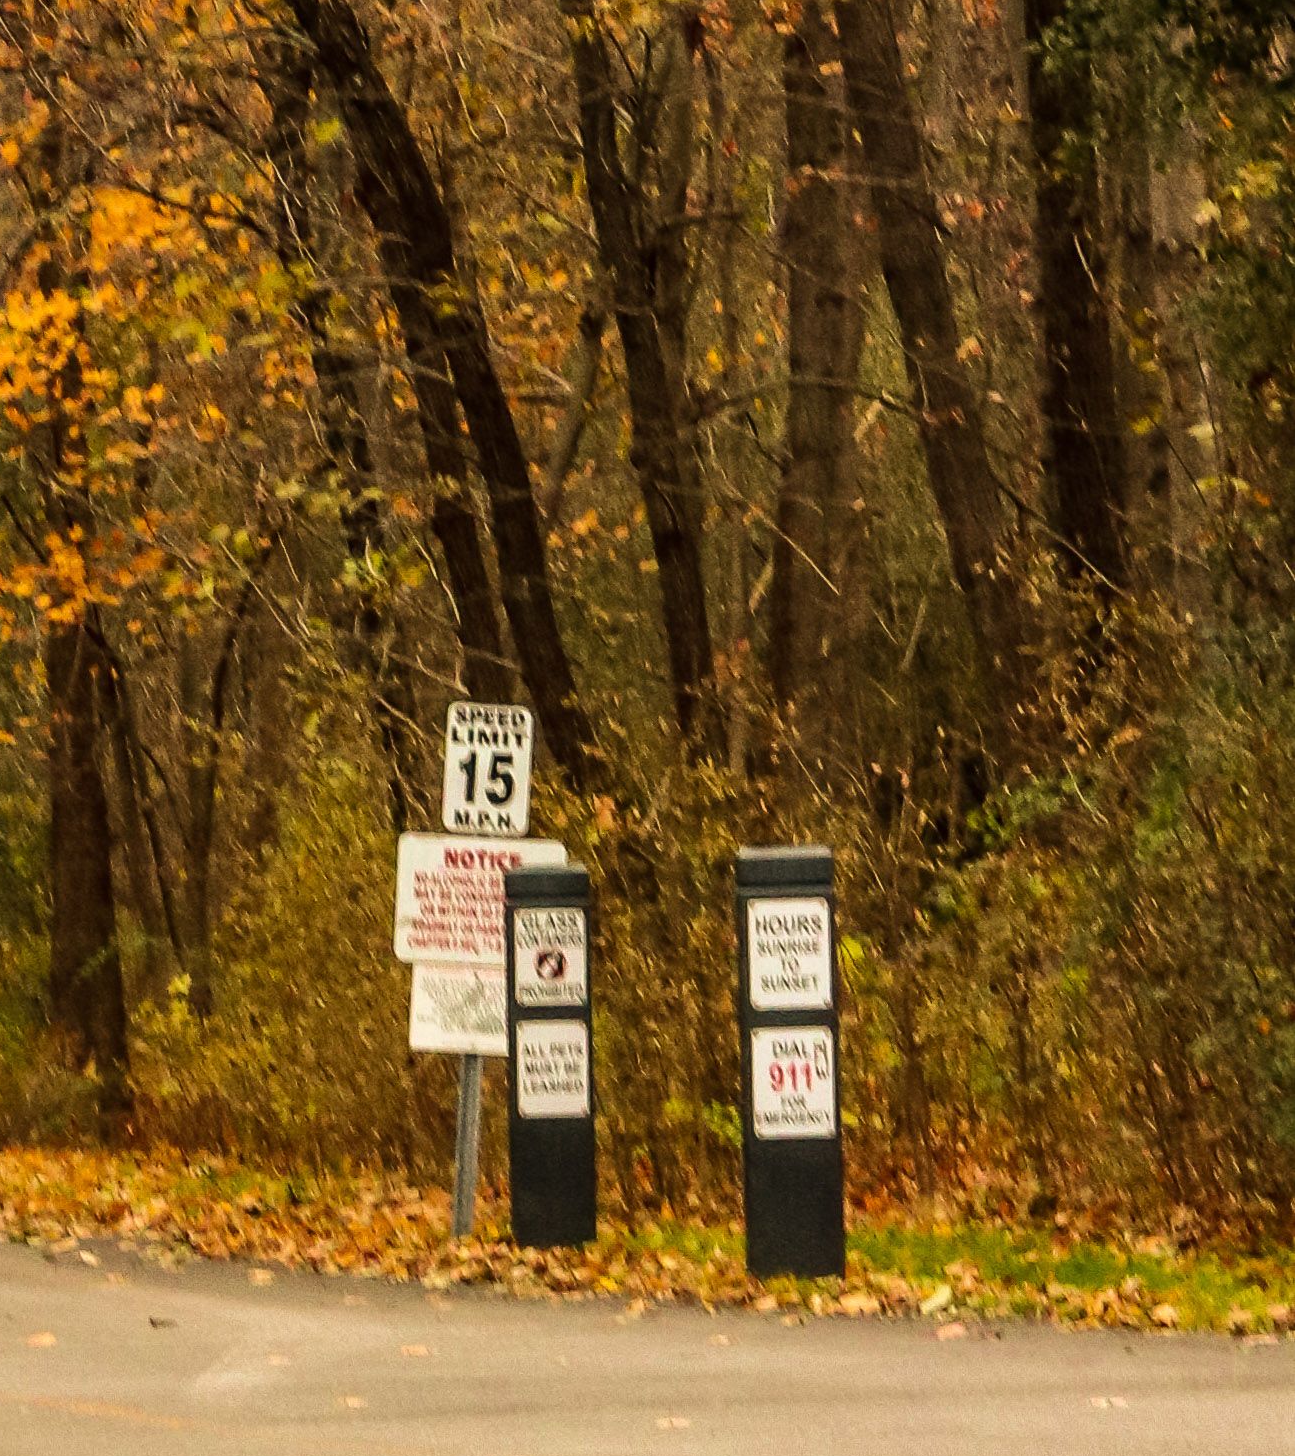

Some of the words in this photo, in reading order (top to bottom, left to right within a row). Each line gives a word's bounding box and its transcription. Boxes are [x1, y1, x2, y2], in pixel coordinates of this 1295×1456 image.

[455, 707, 525, 727] SPEED
[452, 727, 525, 748] LIMIT
[460, 752, 515, 804] 15
[520, 912, 580, 930] GLASS
[755, 915, 822, 935] HOURS
[757, 939, 821, 957] SUNRISE
[781, 957, 800, 974] TO
[761, 974, 819, 992] SUNSET
[524, 1042, 545, 1058] ALL
[550, 1042, 583, 1058] PETS
[772, 1040, 807, 1059] DIAL
[524, 1061, 559, 1076] MUST
[563, 1062, 581, 1076] BE
[770, 1062, 813, 1093] 911
[523, 1079, 584, 1094] LEASHED
[781, 1095, 807, 1110] FOR
[757, 1109, 830, 1125] EMERGENCY
